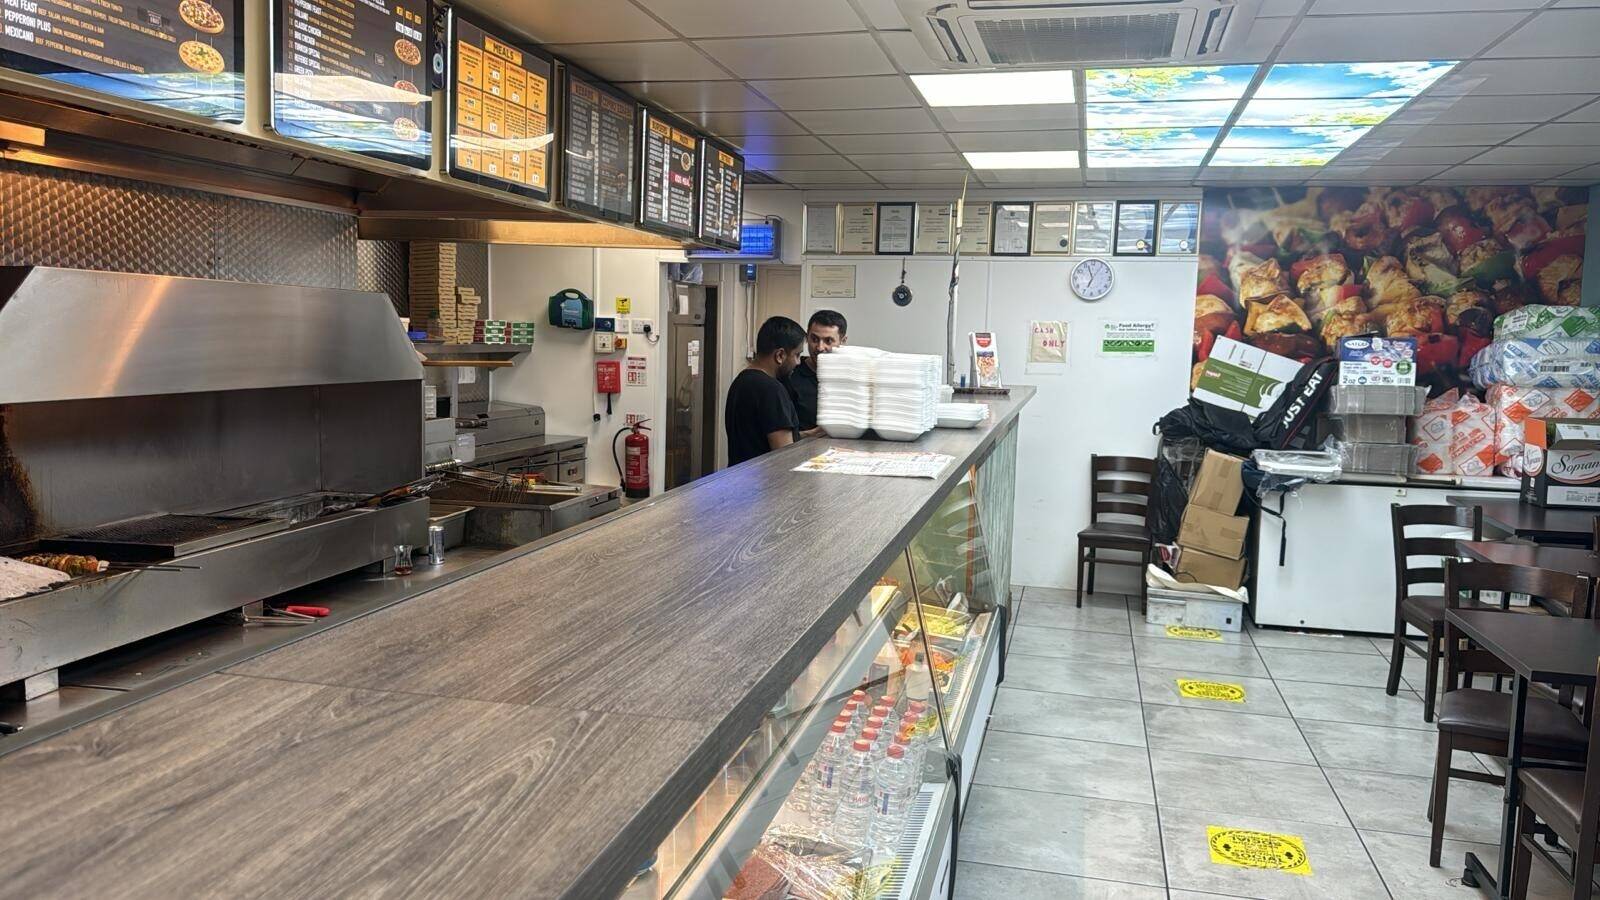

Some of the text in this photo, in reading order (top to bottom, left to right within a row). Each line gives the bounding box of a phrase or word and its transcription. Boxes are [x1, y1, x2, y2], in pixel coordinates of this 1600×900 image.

[20, 0, 38, 14] FEAST
[4, 8, 52, 33] PEPPERONI PLUS
[4, 24, 34, 42] MEXICANO
[493, 42, 514, 60] MEALS
[1042, 340, 1065, 348] ONLY
[1282, 370, 1323, 430] JUST EAT
